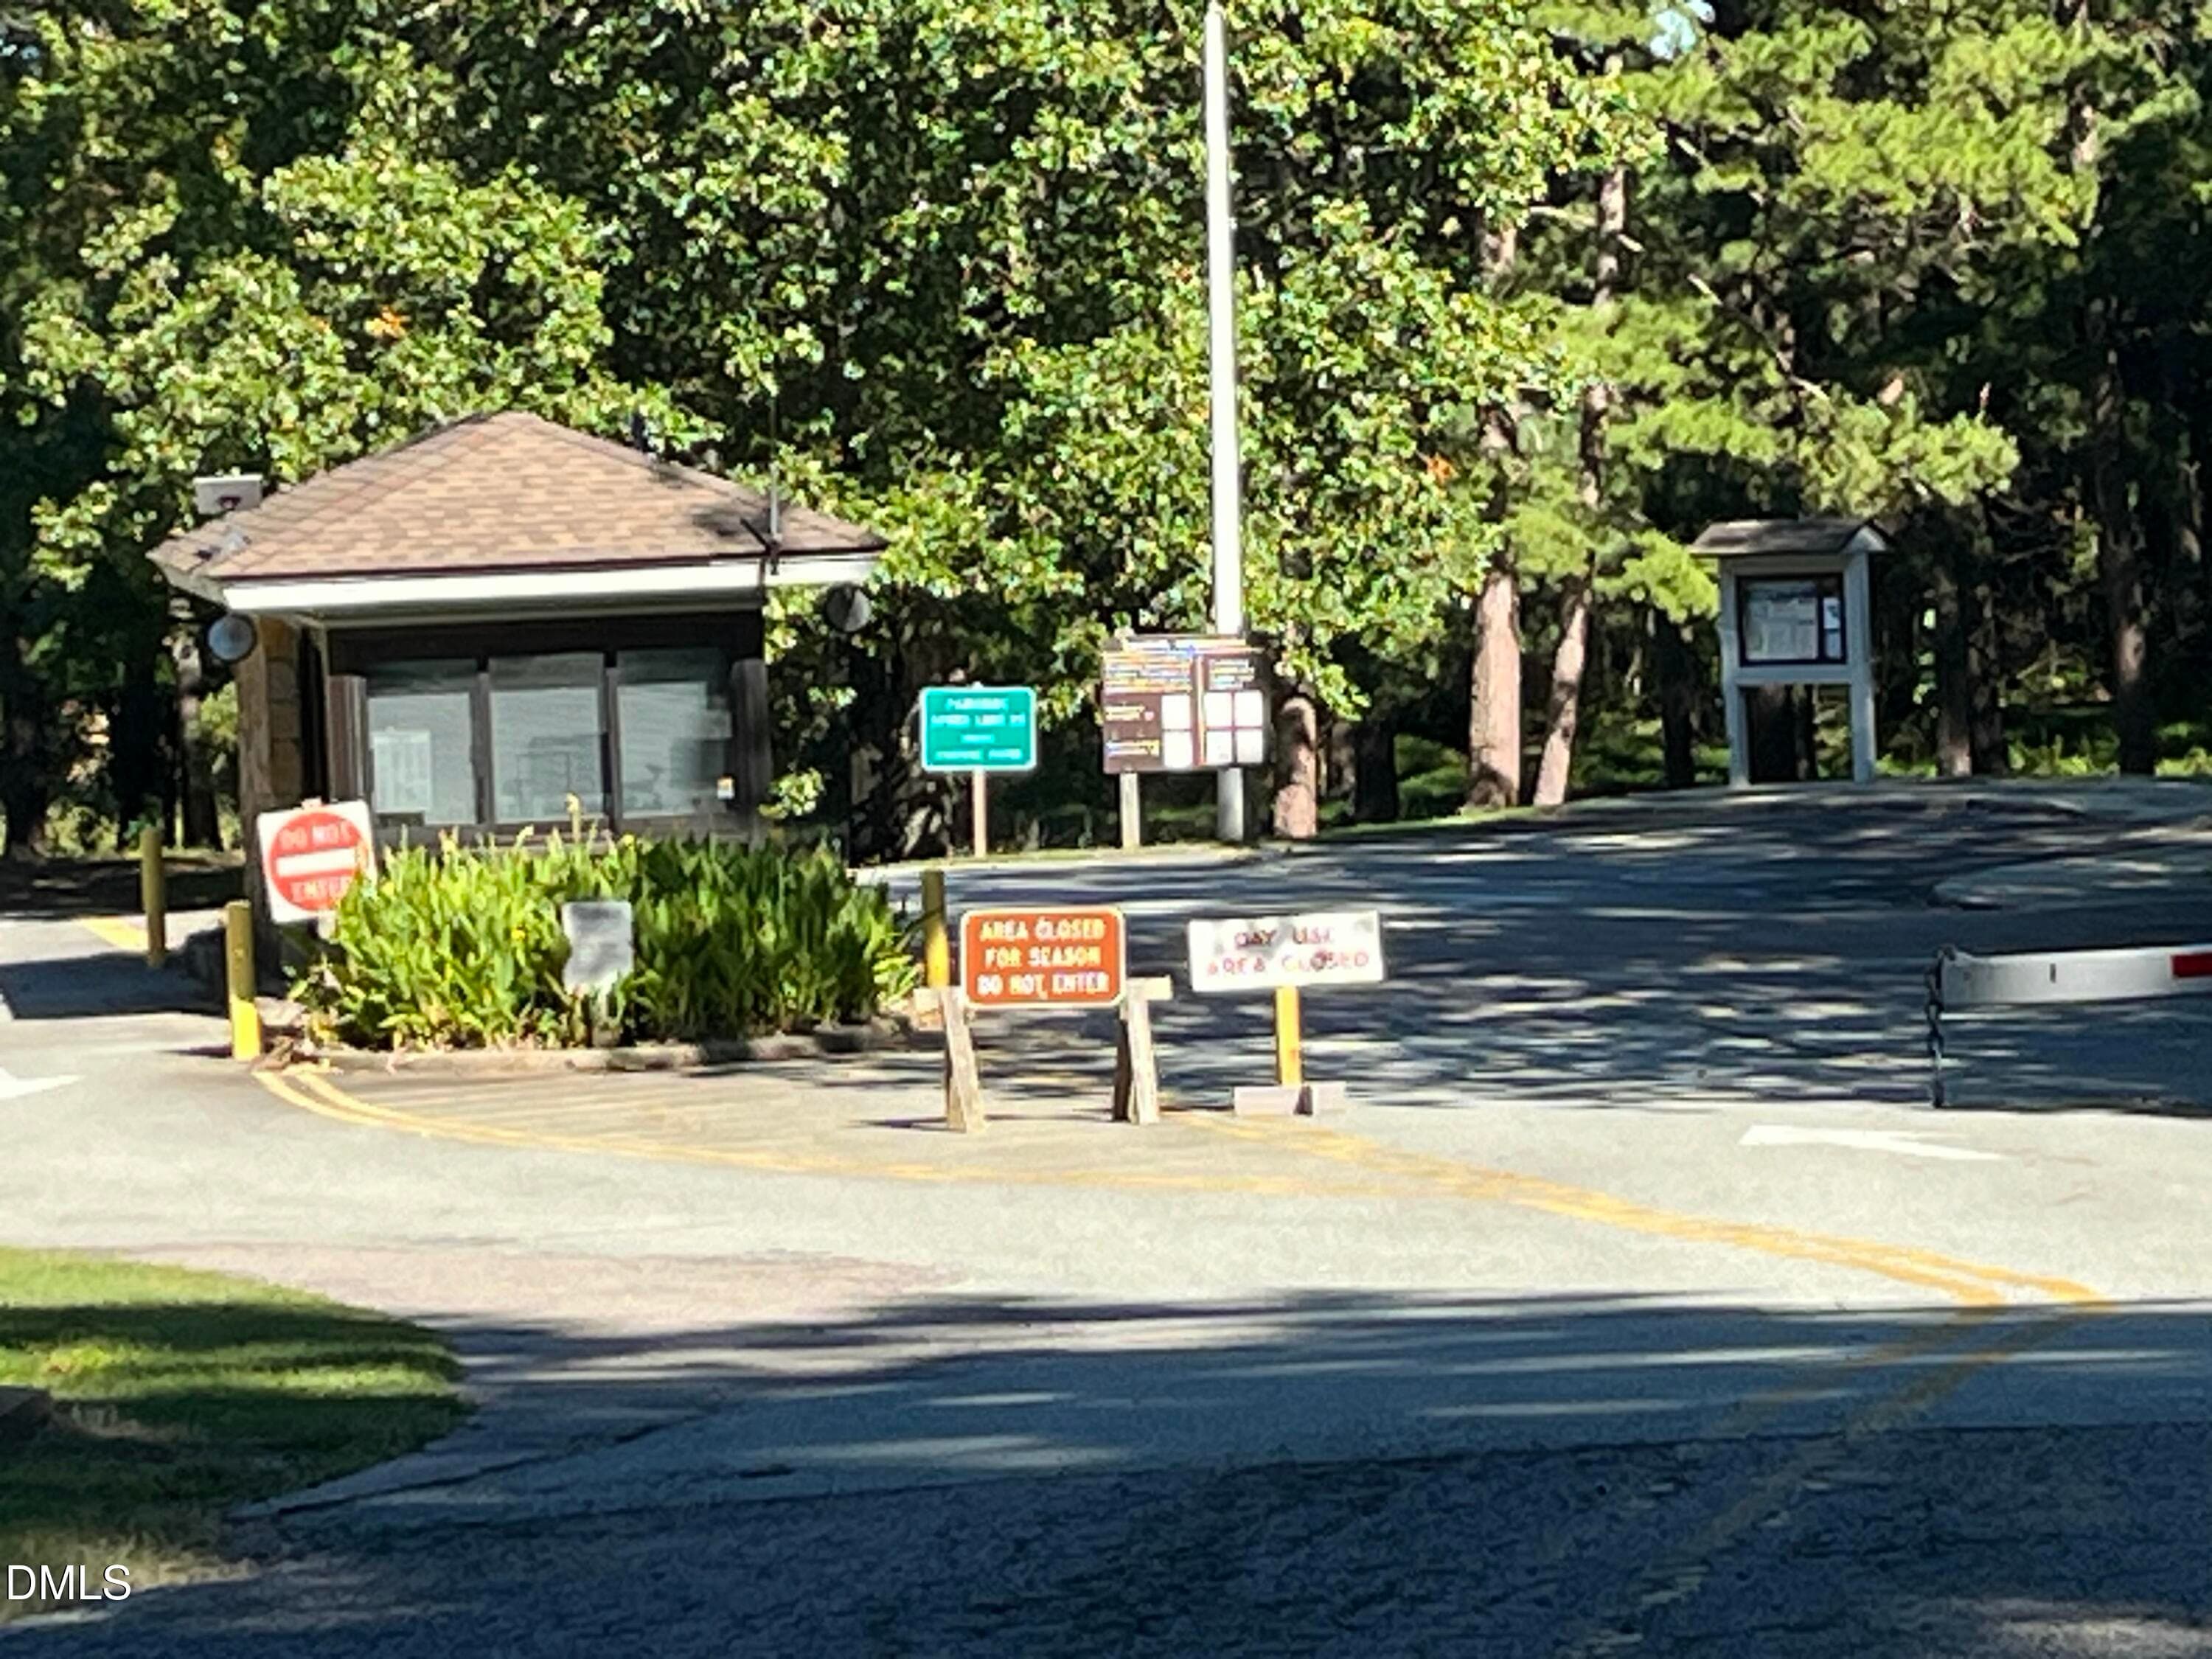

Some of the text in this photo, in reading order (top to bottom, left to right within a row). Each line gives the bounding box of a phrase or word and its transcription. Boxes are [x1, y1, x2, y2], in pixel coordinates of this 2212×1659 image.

[278, 826, 307, 849] DO
[980, 917, 1105, 942] AREA CLOSED
[985, 945, 1101, 969] FOR SEASON
[977, 971, 1109, 997] DO NOT ENTER
